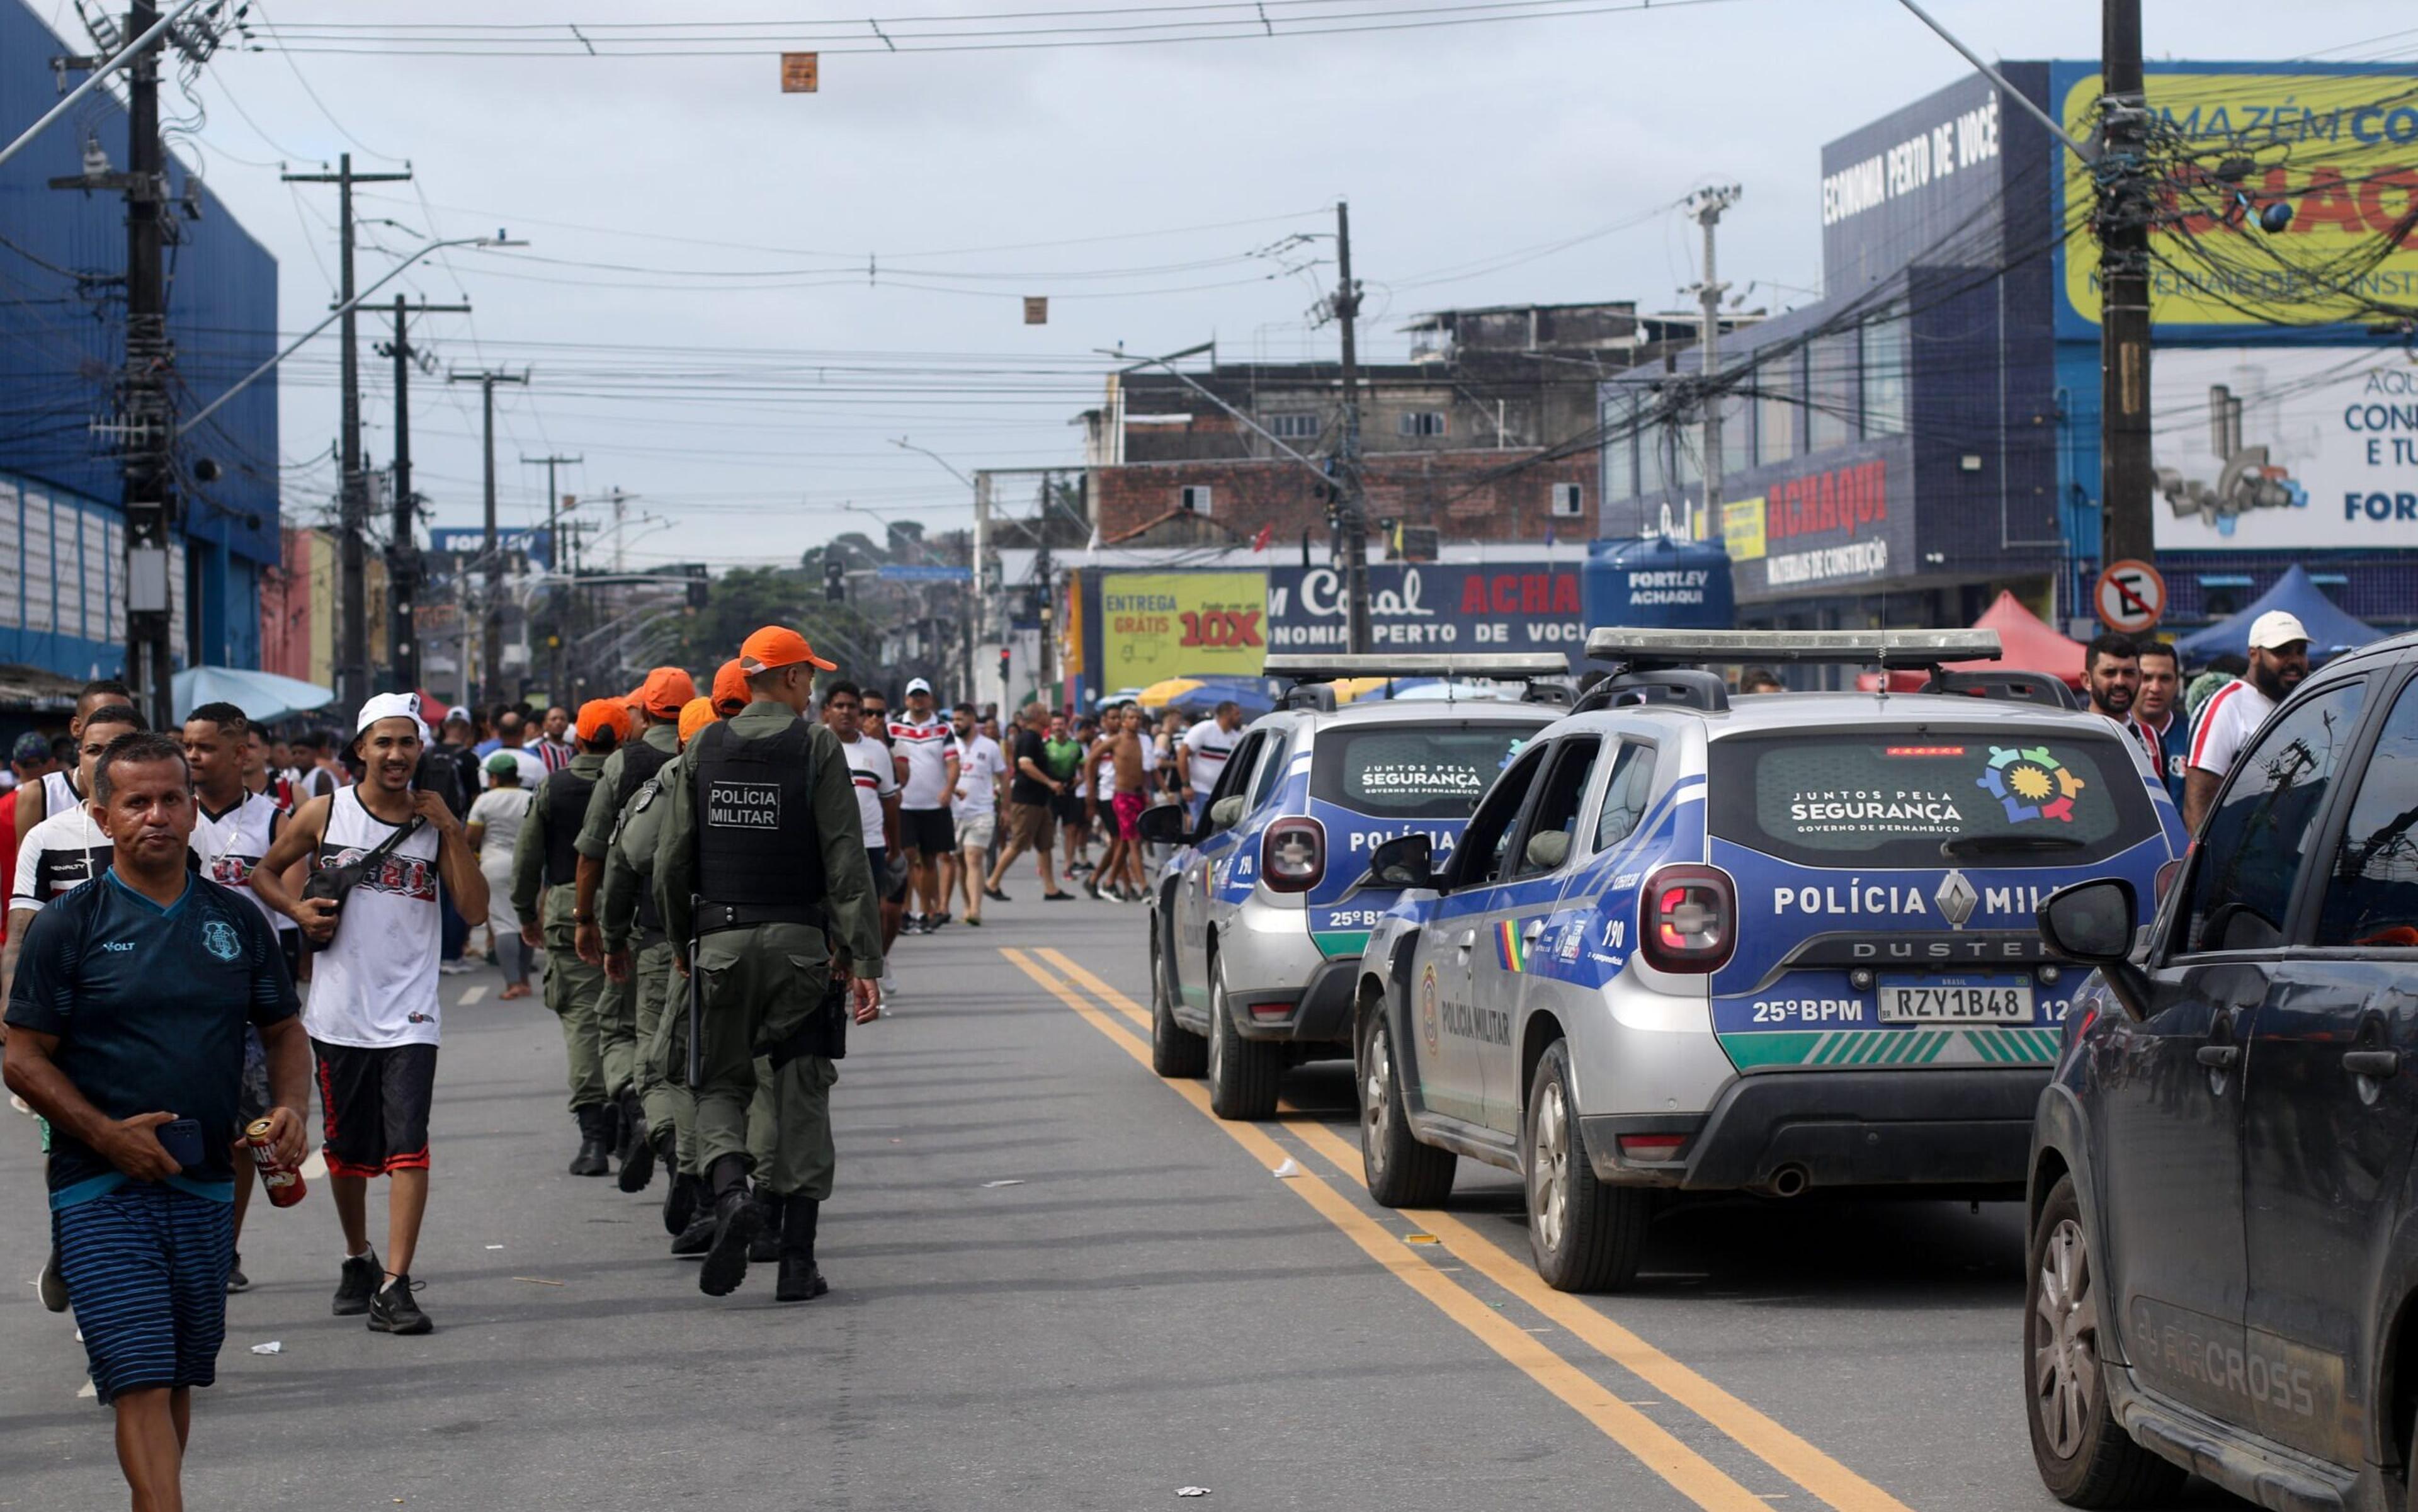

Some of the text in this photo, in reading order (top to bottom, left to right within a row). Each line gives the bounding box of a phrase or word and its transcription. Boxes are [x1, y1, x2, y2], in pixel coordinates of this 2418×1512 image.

[1887, 133, 1930, 199] PERTO
[1933, 121, 1953, 179] DE
[1956, 89, 1999, 168] VOCÊ
[2345, 403, 2418, 431] CON
[2367, 438, 2381, 465] E
[1768, 458, 1887, 542] ACHAQUI
[1629, 571, 1708, 588] FORTLEV
[1106, 594, 1177, 611] ENTREGA
[1460, 574, 1581, 614] ACHA
[1630, 591, 1703, 605] ACHAQUI
[1114, 611, 1169, 634] GRÁTIS
[1179, 610, 1264, 647] 10X
[1268, 625, 1349, 645] NOMIA
[1373, 623, 1457, 644] PERTO
[1475, 623, 1509, 642] DE
[1365, 765, 1427, 773] JUNTOS
[1362, 773, 1481, 788] SEGURANÇA
[711, 788, 776, 805] POLÍCIA
[1793, 790, 1952, 802] JUNTOS PELA
[711, 809, 775, 824] MILITAR
[1791, 802, 1963, 824] SEGURANÇA
[1879, 824, 1960, 833] PERNAMBUCO
[1774, 877, 1927, 914] POLÍCIA
[1601, 919, 1625, 948] 190
[1942, 977, 1967, 986] BRASIL
[1897, 989, 2019, 1016] RZY1B48
[1441, 992, 1511, 1046] POLÍCIA MILITAR
